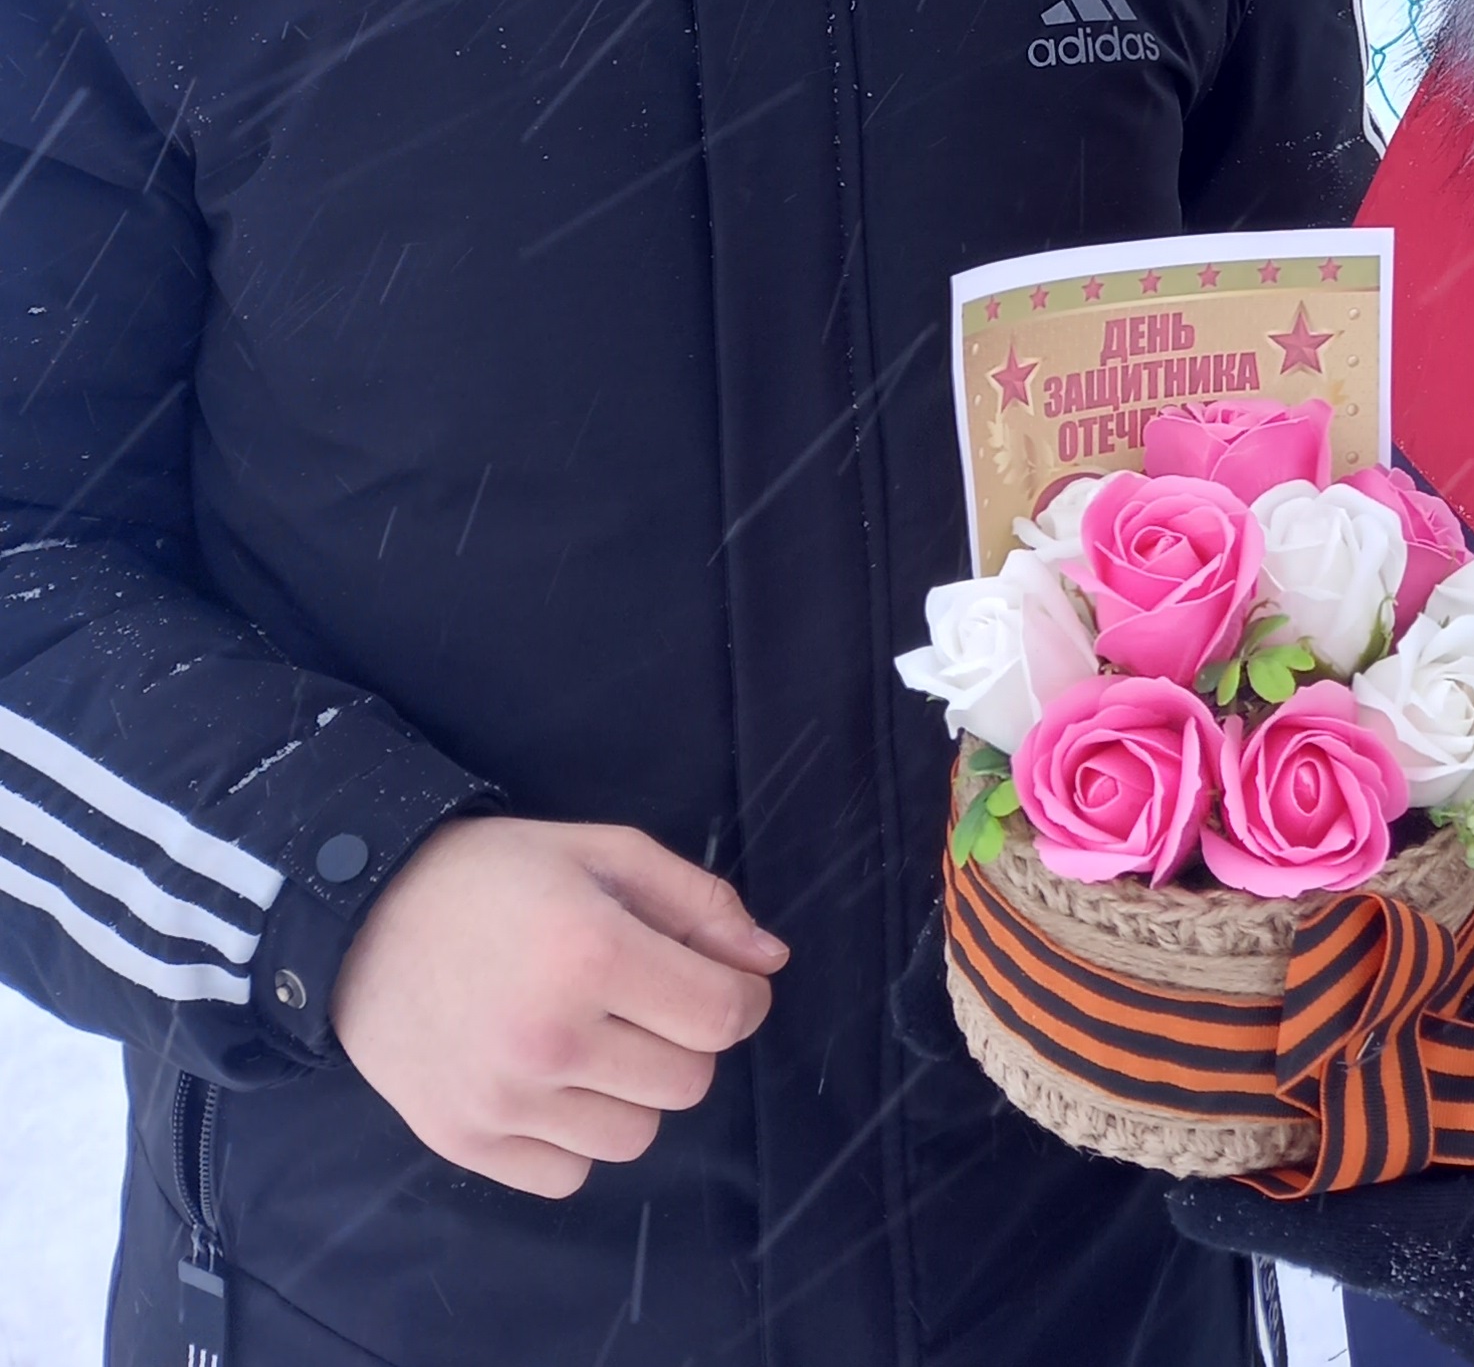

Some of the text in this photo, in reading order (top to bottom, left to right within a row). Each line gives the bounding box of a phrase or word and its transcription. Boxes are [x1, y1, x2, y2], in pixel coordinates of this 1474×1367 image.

[1027, 26, 1160, 67] adidas
[1100, 311, 1196, 366] ДЕНЬ
[1043, 351, 1260, 418] ЗАЩИТНИКА
